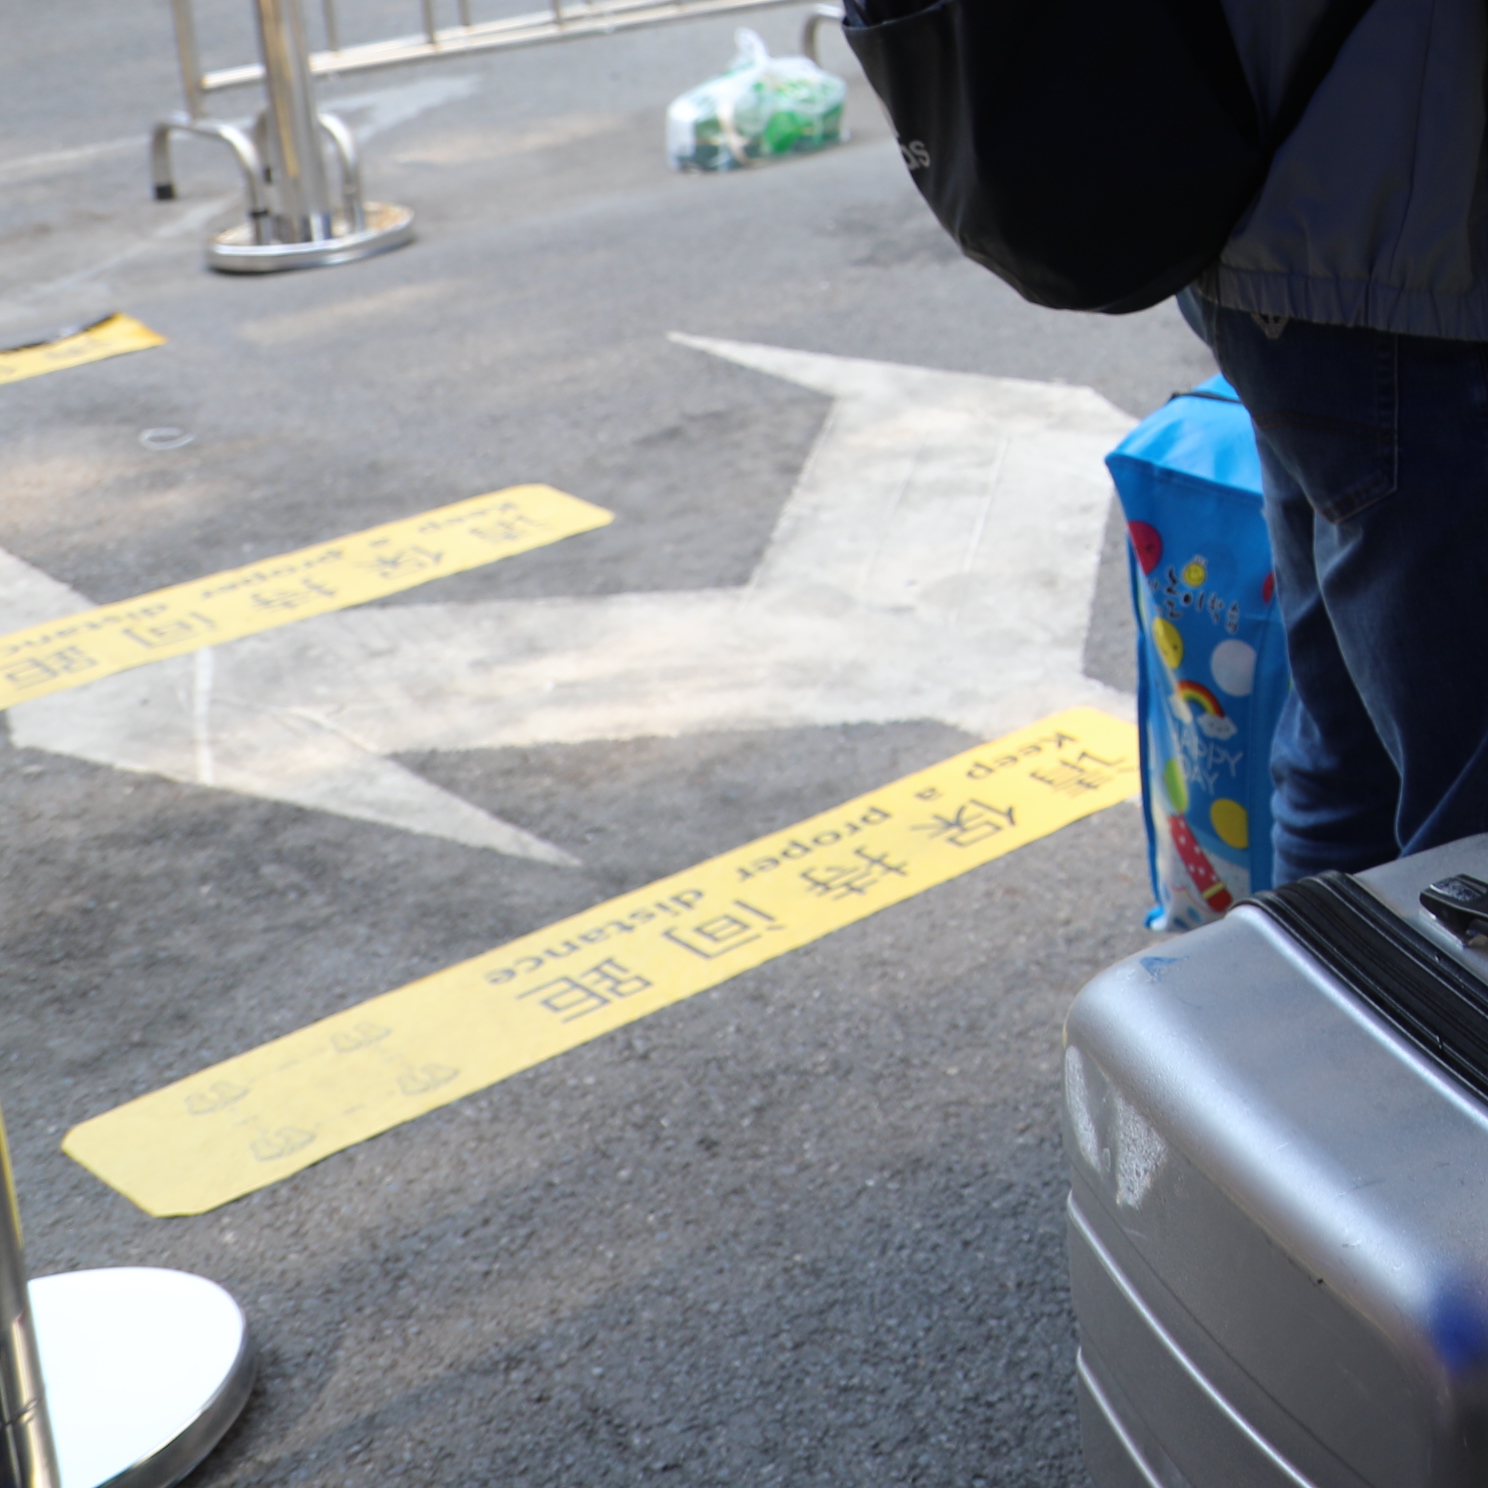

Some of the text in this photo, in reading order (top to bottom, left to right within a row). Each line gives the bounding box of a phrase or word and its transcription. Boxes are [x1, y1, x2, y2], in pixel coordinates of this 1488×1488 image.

[914, 787, 943, 802] a
[516, 752, 1138, 1023] 请保持间距
[735, 805, 892, 883] proper
[482, 888, 704, 985] distance
